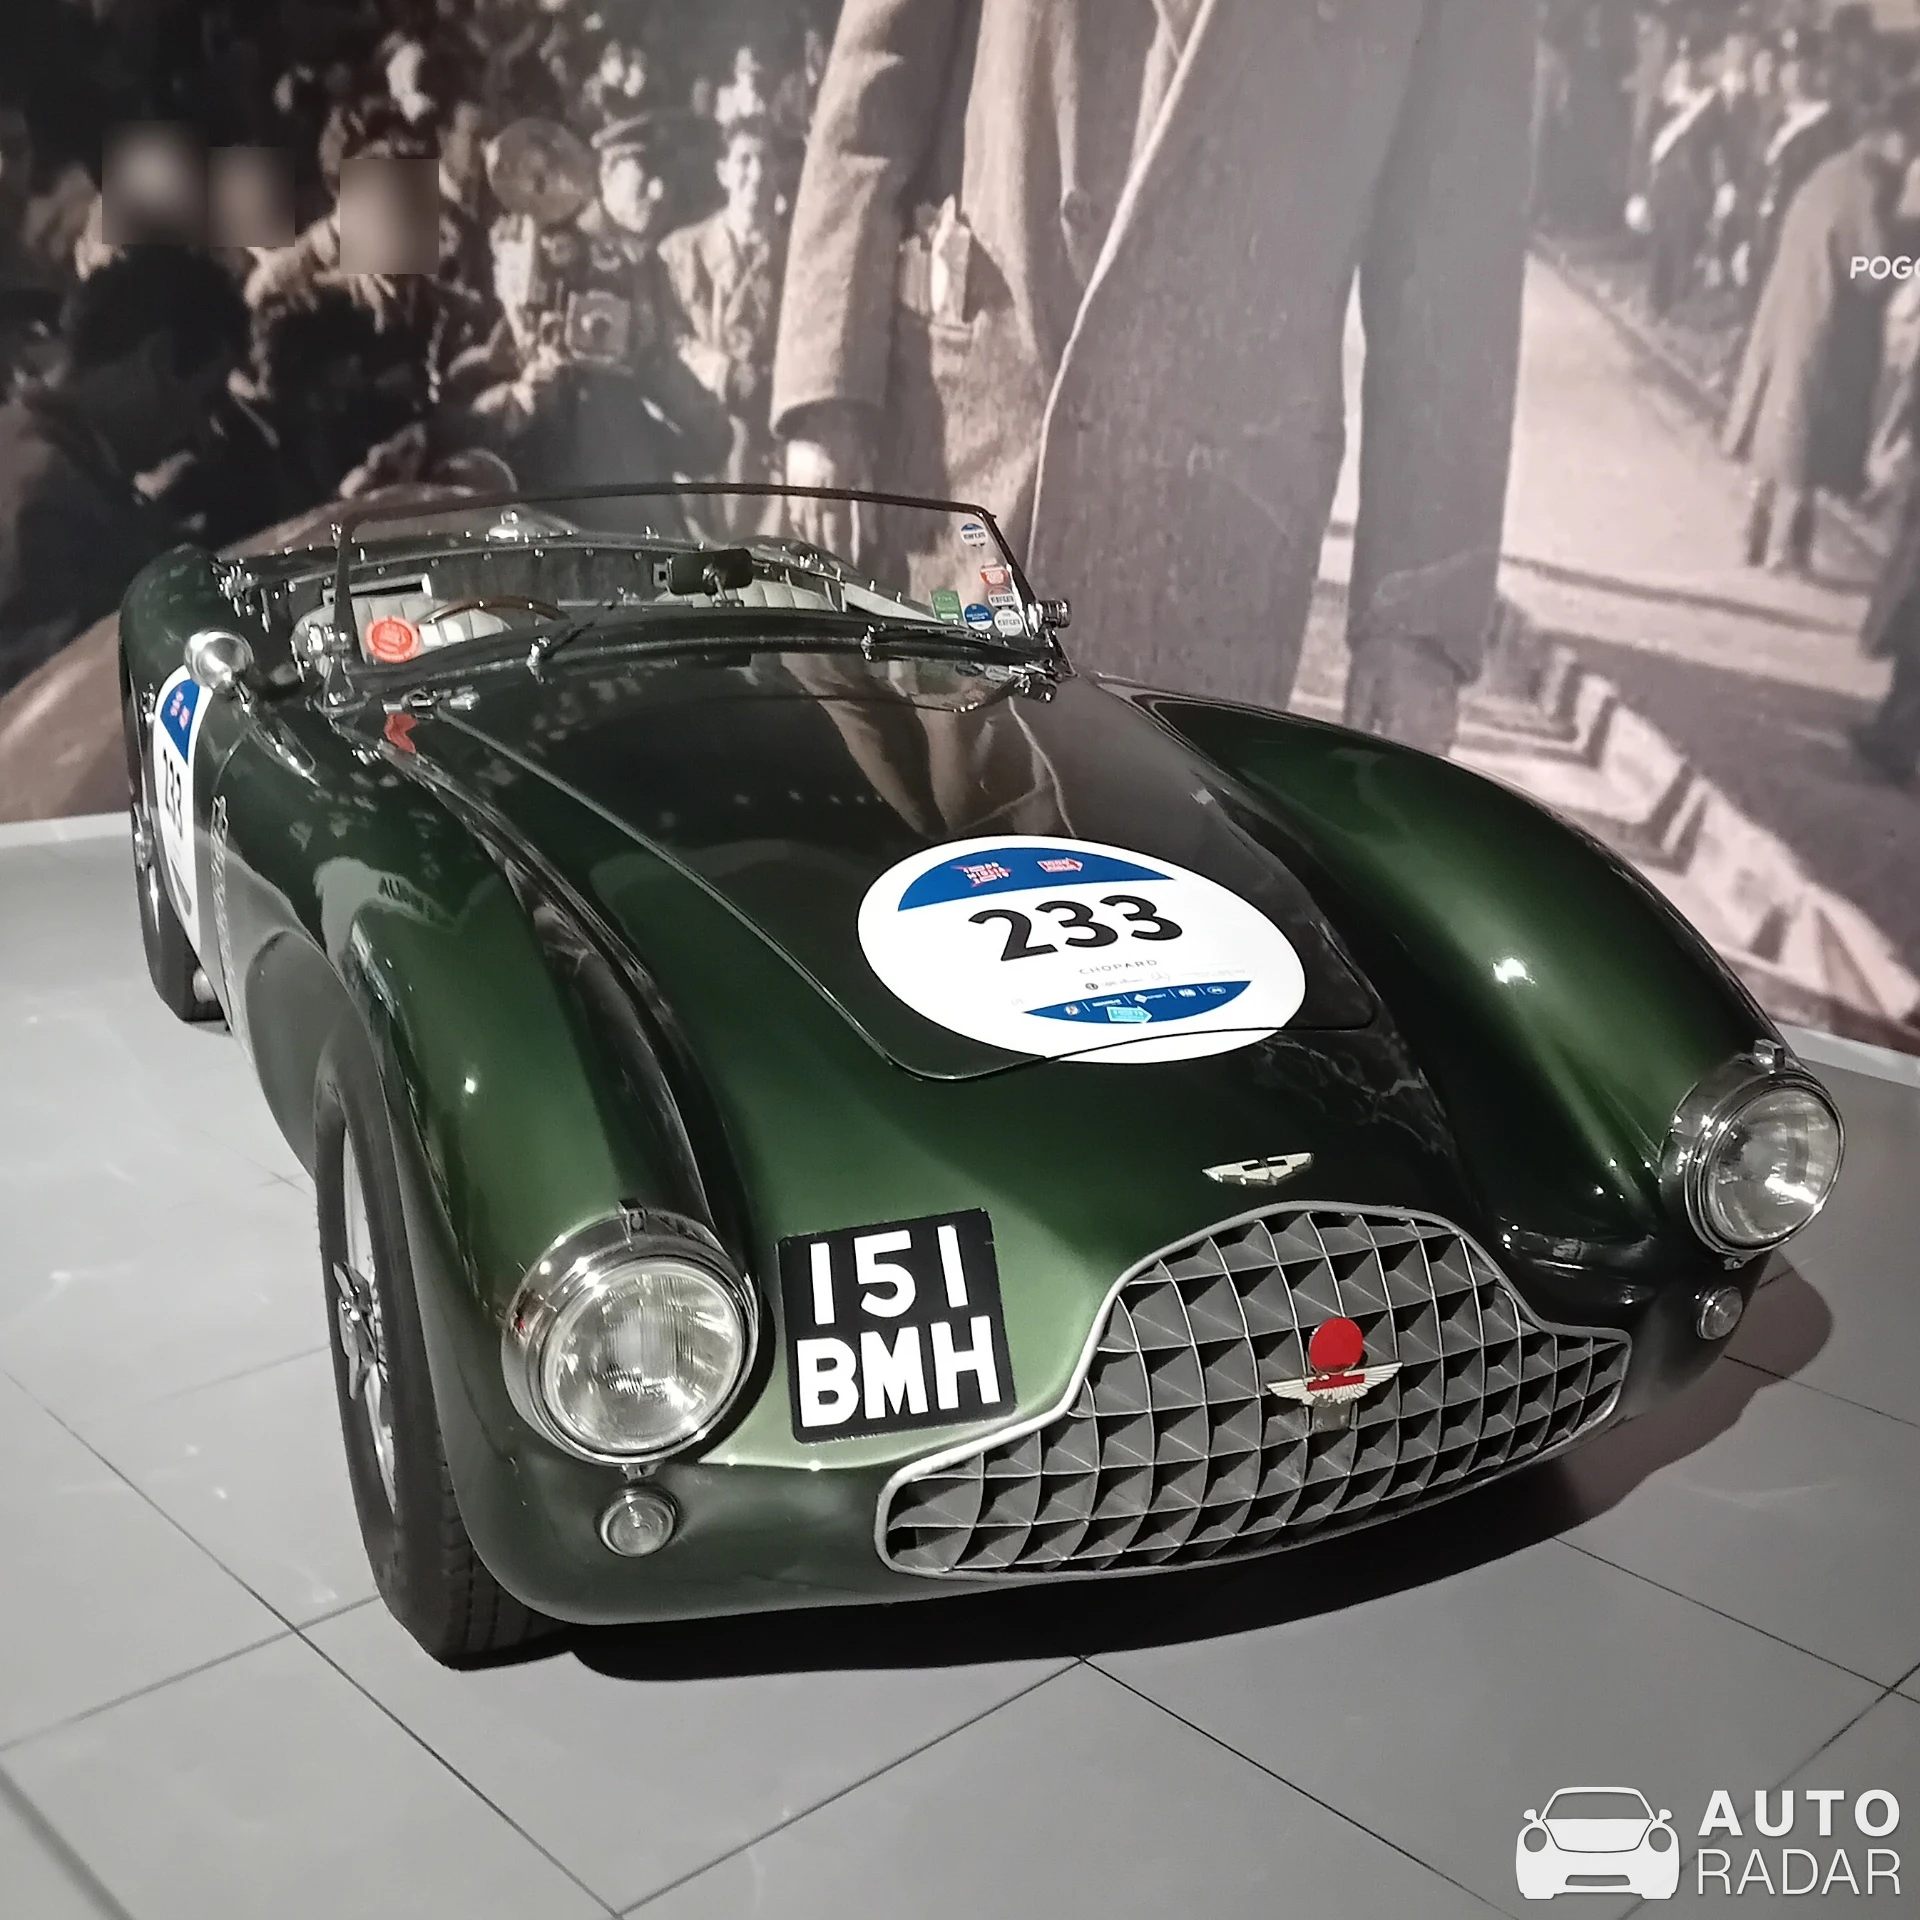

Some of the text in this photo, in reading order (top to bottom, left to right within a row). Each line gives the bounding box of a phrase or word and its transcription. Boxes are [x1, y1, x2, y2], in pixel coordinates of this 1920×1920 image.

[1849, 255, 1920, 280] POG
[968, 895, 1182, 962] 233
[1078, 959, 1158, 975] CHOPARD
[810, 1224, 968, 1326] 151
[796, 1314, 1001, 1428] BMH
